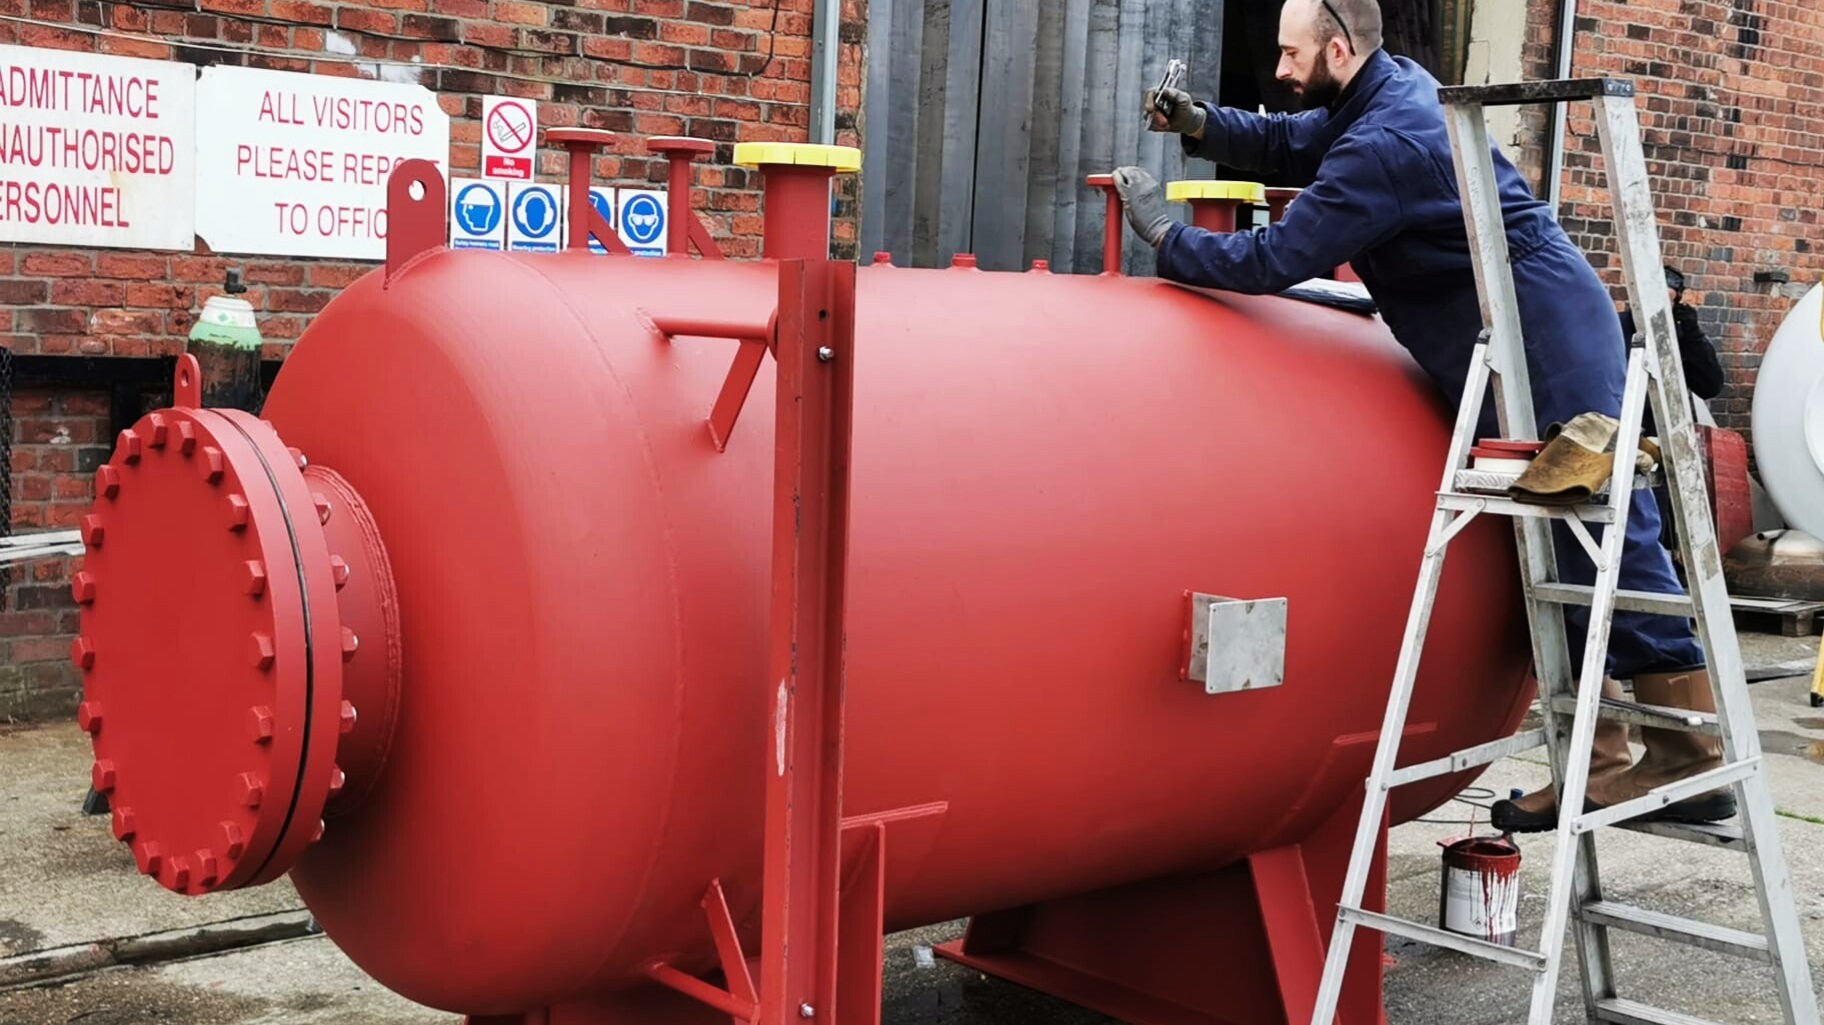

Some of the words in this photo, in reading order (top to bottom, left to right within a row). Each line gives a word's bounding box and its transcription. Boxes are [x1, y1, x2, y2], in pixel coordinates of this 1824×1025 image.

[258, 90, 304, 125] ALL
[313, 95, 423, 136] VISITORS
[237, 144, 334, 182] PLEASE
[343, 153, 439, 186] REP
[503, 157, 515, 166] No
[0, 180, 129, 228] RSONNEL
[275, 202, 308, 235] TO
[317, 204, 388, 239] OFFIC
